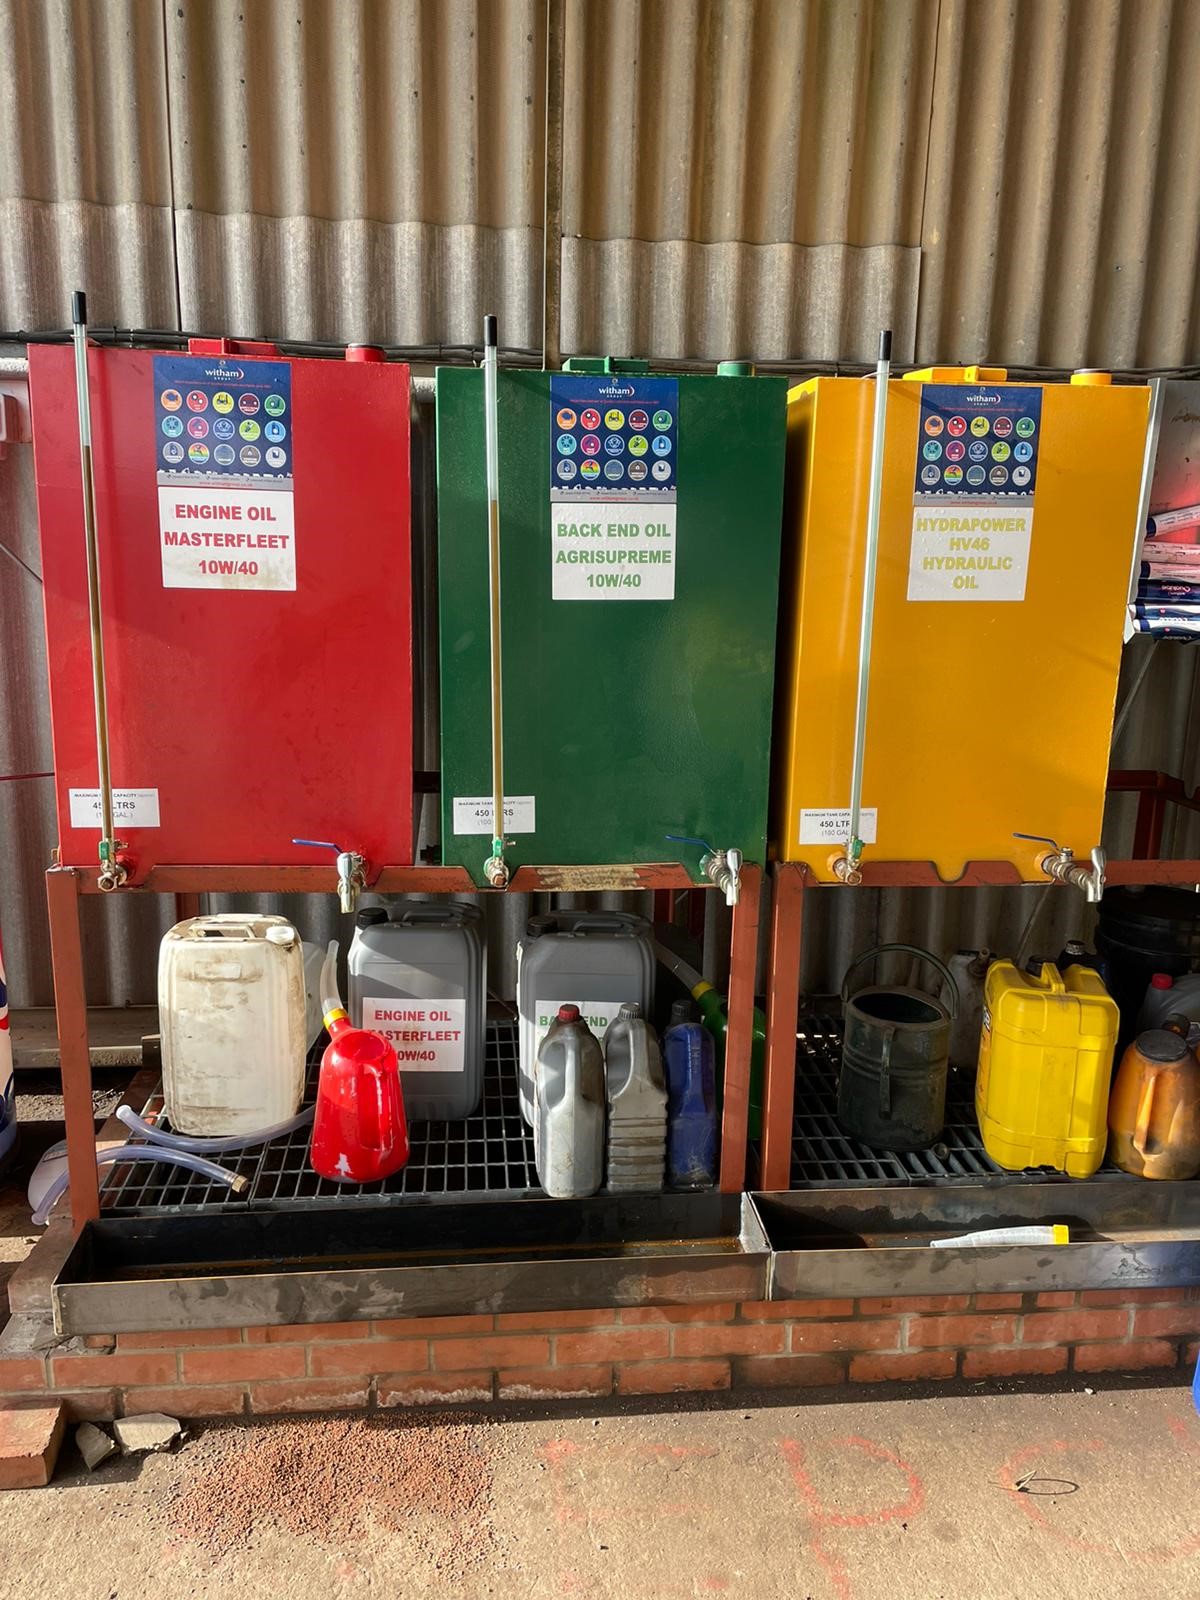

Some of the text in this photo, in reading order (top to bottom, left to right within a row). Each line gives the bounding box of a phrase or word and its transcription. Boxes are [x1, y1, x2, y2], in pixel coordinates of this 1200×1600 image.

[205, 369, 239, 378] witham
[598, 386, 630, 395] witham
[966, 395, 997, 403] witham
[175, 504, 276, 522] ENGINE OIL
[557, 523, 671, 538] BACK END OIL
[916, 518, 1026, 532] HYDRAPOWER
[164, 531, 290, 549] MASTERFLEET
[949, 537, 991, 551] HV46
[556, 550, 672, 564] AGRISUPREME
[922, 557, 1013, 570] HYDRAULIC
[198, 559, 258, 576] 10W/40
[586, 574, 642, 588] 10W/40
[952, 576, 979, 589] OIL
[475, 809, 490, 817] 450
[819, 820, 834, 828] 450
[374, 1009, 452, 1022] ENGINE OIL
[368, 1029, 461, 1041] ASTERFLEET
[397, 1050, 436, 1062] 0W/40
